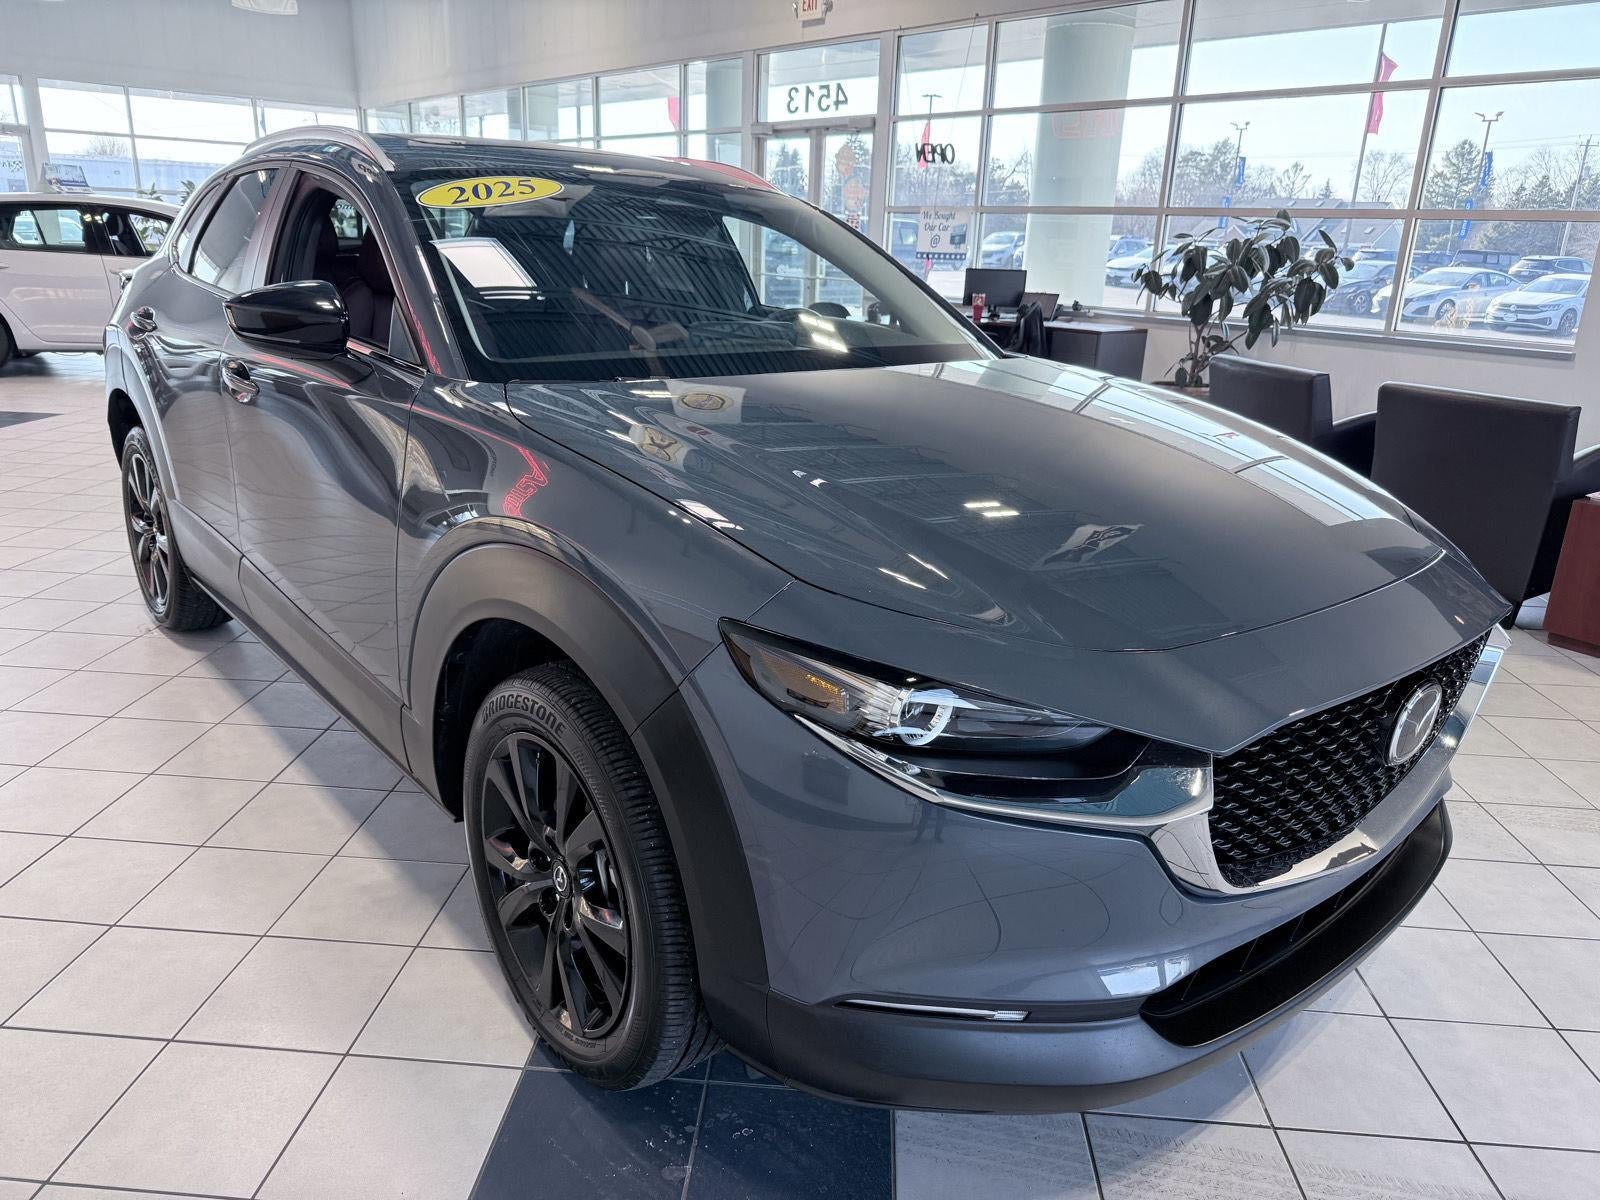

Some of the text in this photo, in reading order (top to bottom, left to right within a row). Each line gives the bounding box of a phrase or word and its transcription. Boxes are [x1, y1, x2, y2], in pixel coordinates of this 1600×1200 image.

[447, 179, 536, 205] 2025
[935, 211, 956, 222] Bought
[939, 223, 949, 231] Car
[482, 694, 566, 738] BRIDGESTONE
